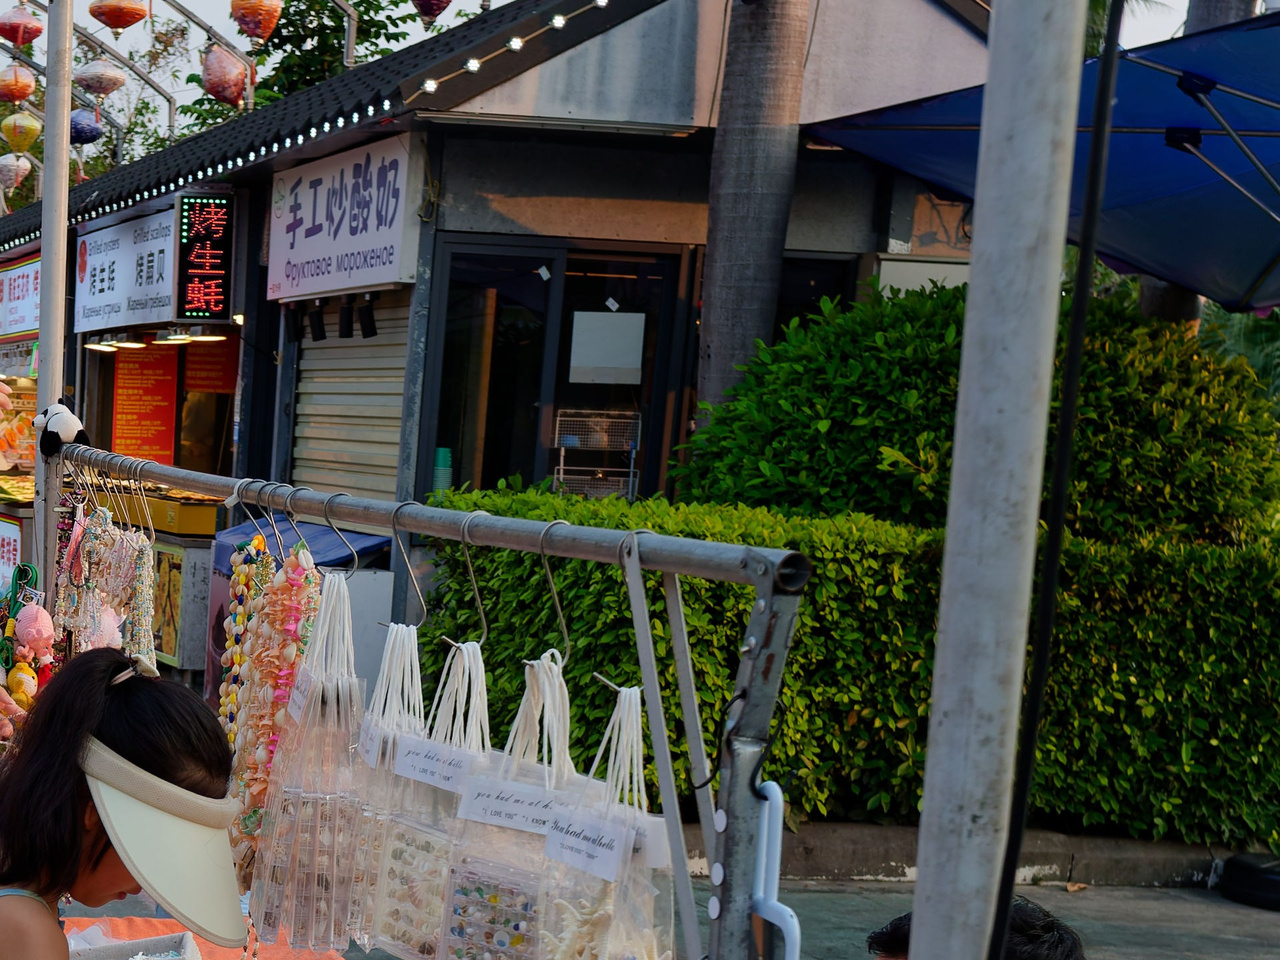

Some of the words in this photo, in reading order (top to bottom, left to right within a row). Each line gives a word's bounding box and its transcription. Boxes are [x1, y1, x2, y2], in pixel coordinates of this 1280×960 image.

[133, 223, 150, 245] Grilled
[134, 249, 166, 288] 烤扇贝
[184, 202, 228, 312] 烤生蚝
[285, 256, 333, 288] Фруктовое
[336, 244, 395, 279] мороженое
[89, 260, 116, 296] 烤生蚝
[474, 791, 491, 800] you
[494, 790, 514, 802] had
[490, 809, 503, 818] LOVE
